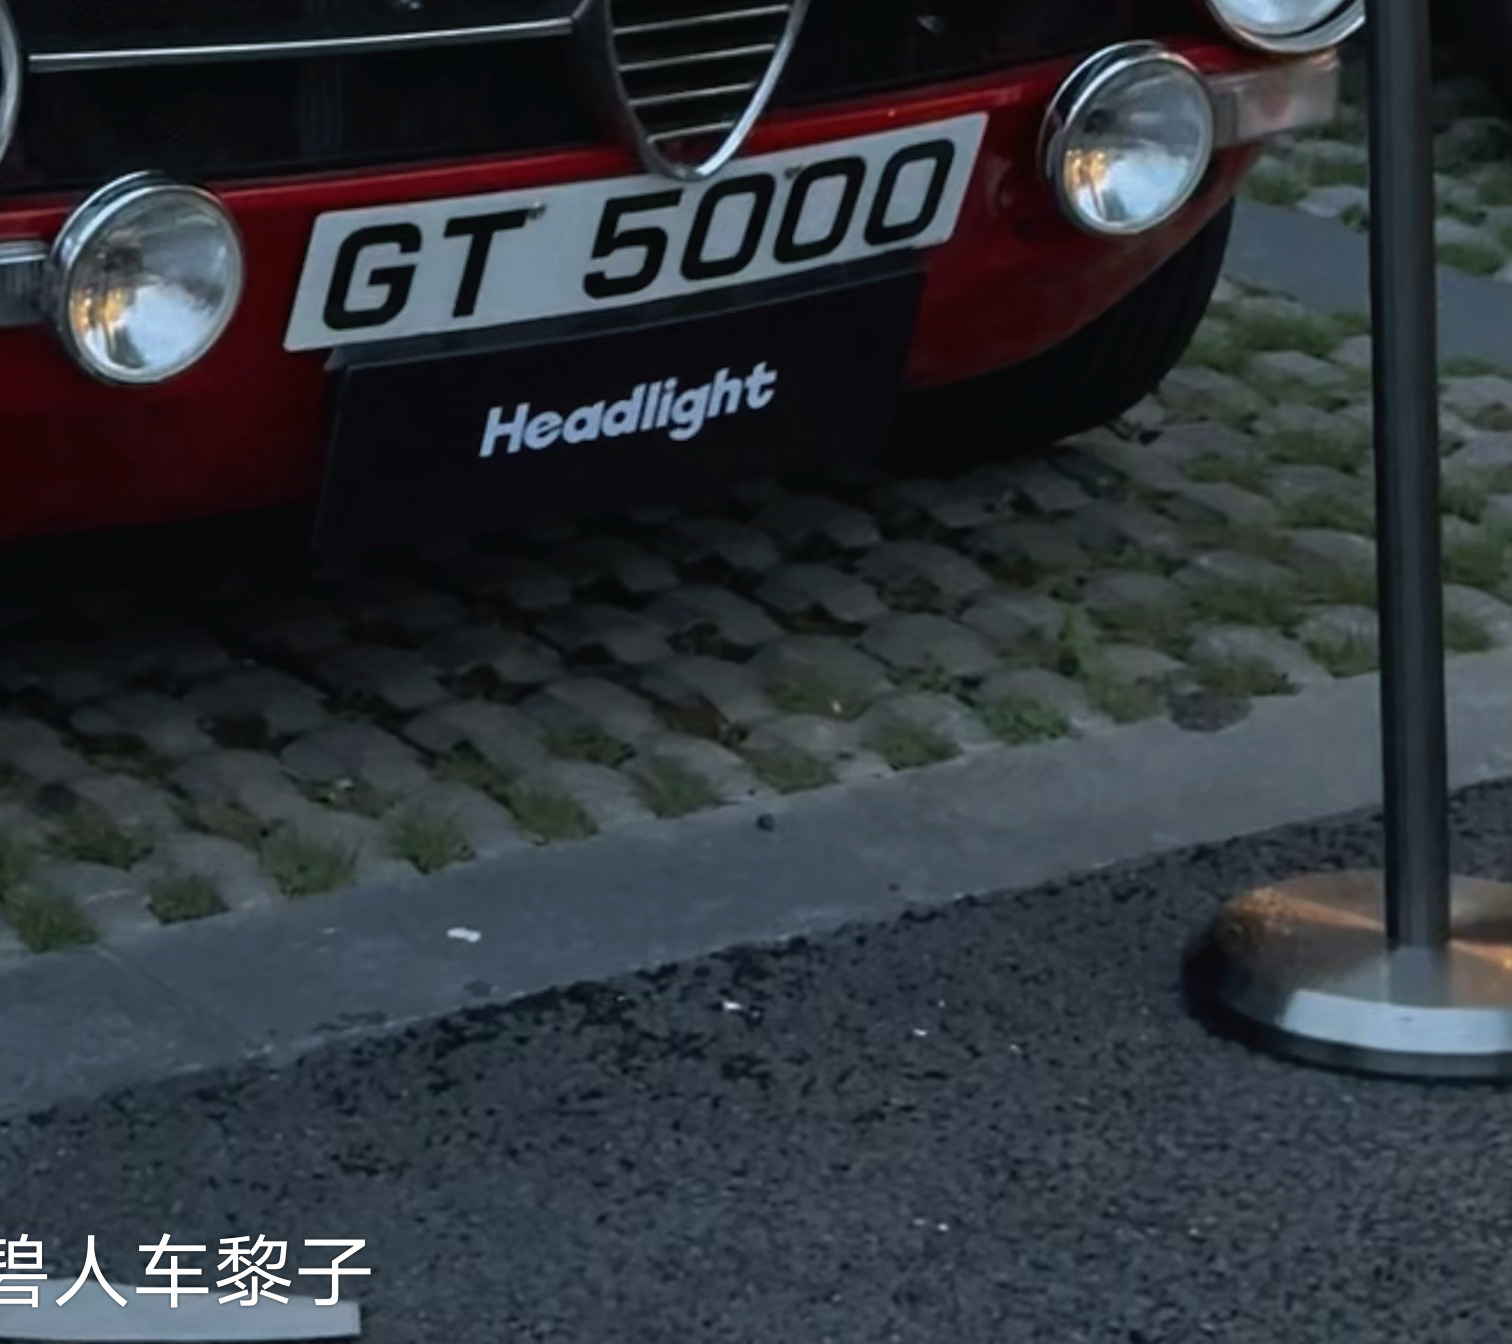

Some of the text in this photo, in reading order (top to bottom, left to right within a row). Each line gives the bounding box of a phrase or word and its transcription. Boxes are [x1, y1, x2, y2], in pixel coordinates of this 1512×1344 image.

[322, 139, 956, 330] GT 5000
[479, 362, 778, 457] Headlight
